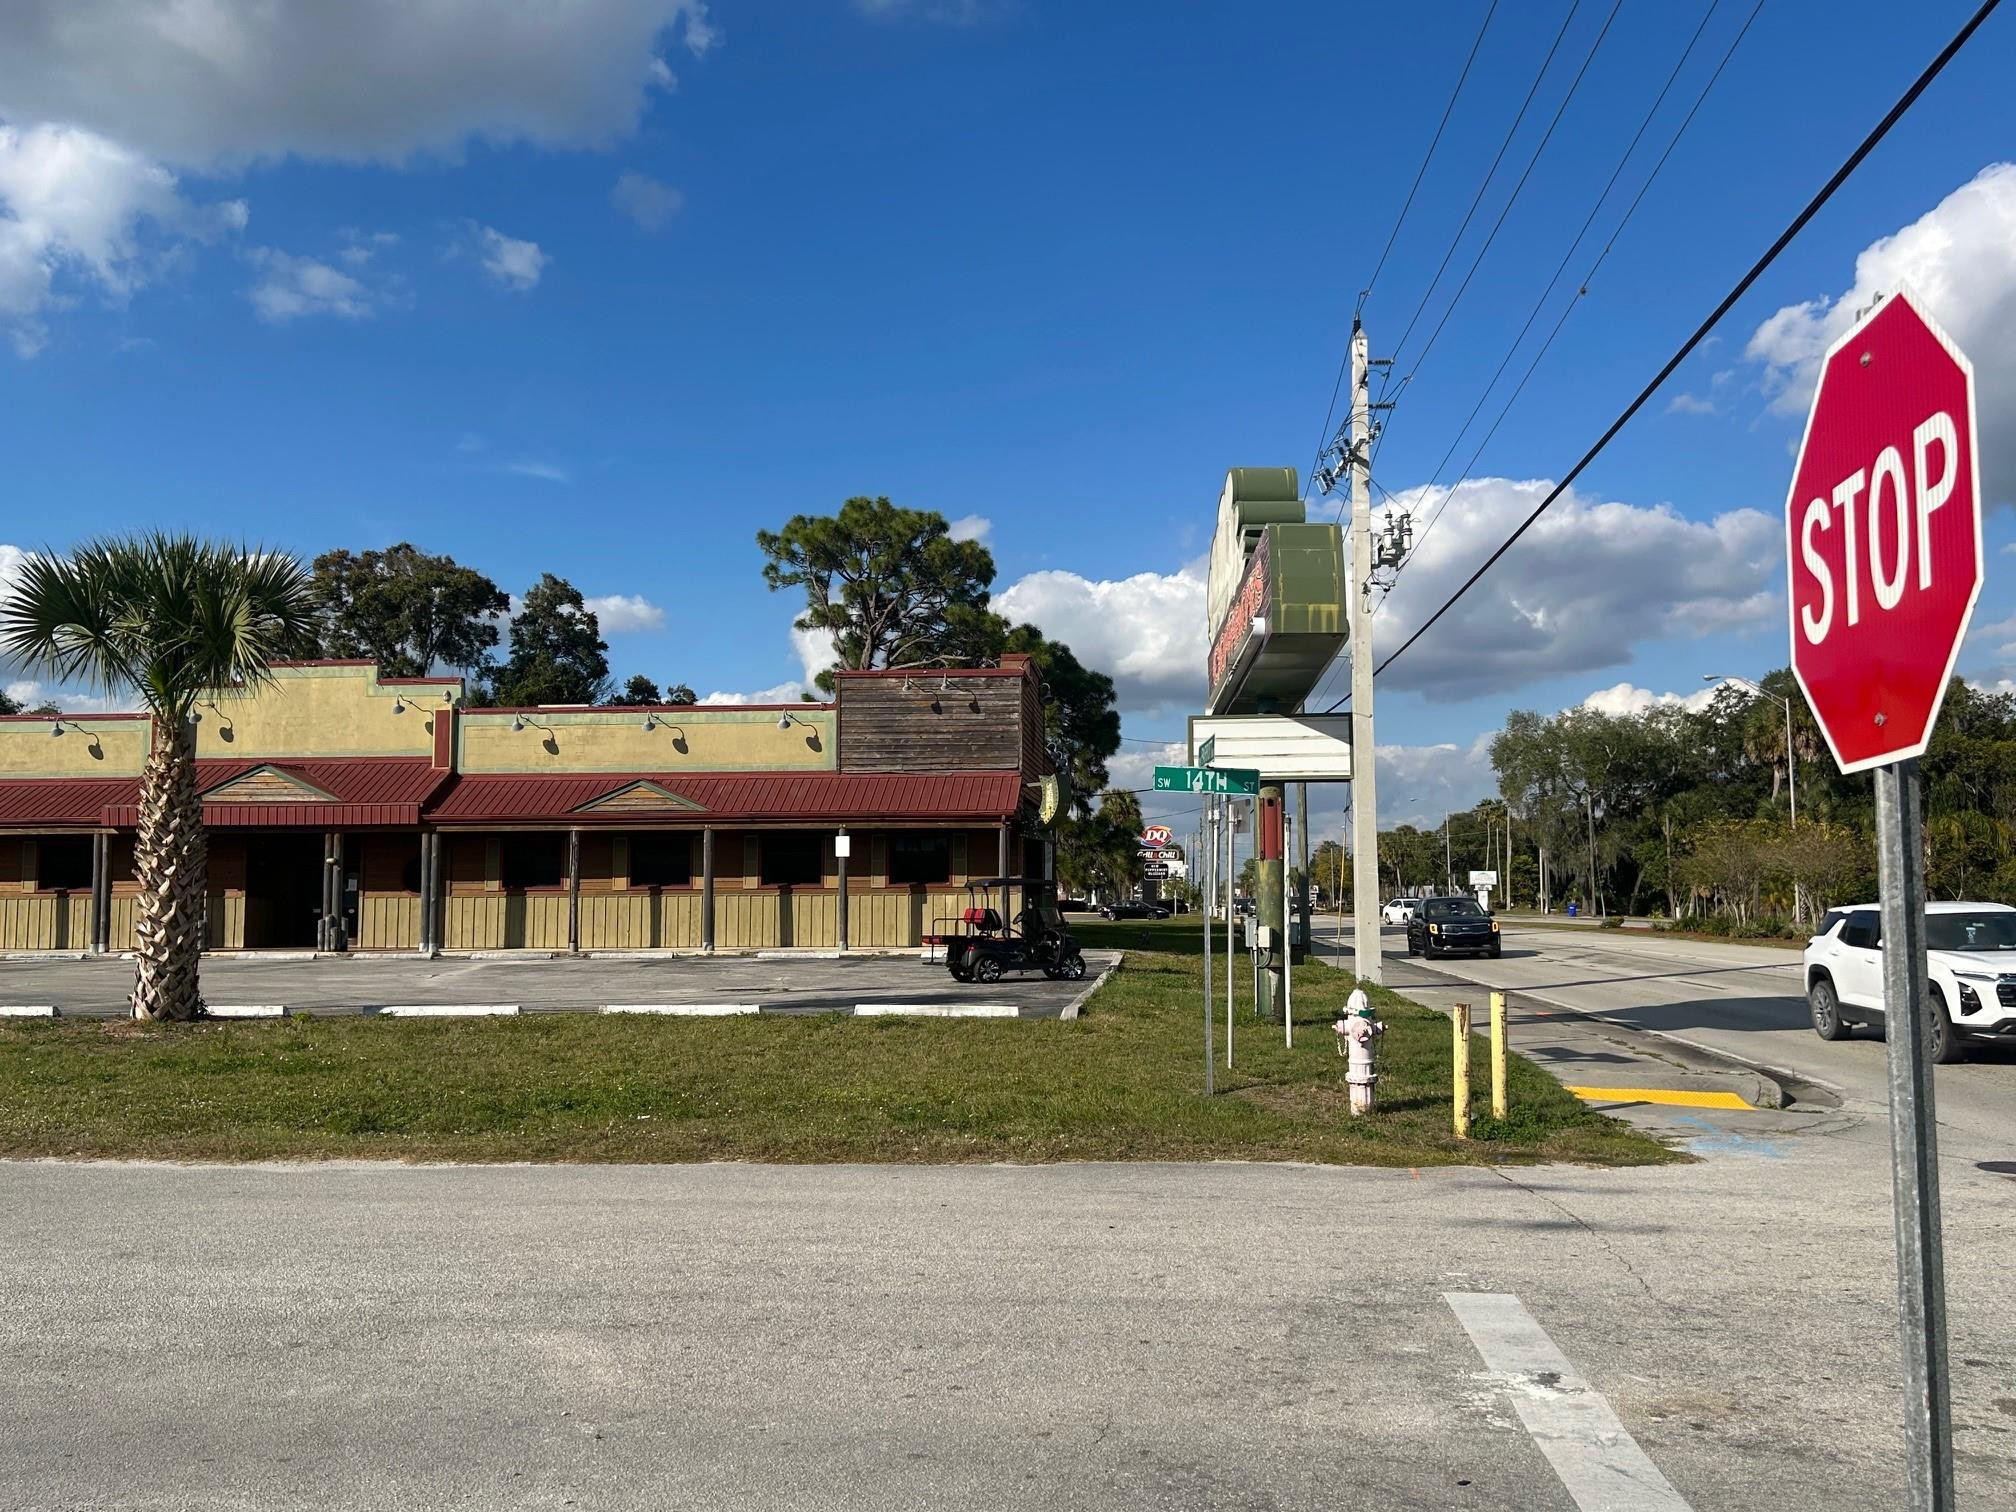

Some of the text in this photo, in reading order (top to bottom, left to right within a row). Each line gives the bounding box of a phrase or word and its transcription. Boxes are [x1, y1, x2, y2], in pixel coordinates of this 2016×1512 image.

[1802, 411, 1958, 645] STOP
[1157, 770, 1255, 791] SW 14TH ST
[1146, 830, 1168, 843] DQ
